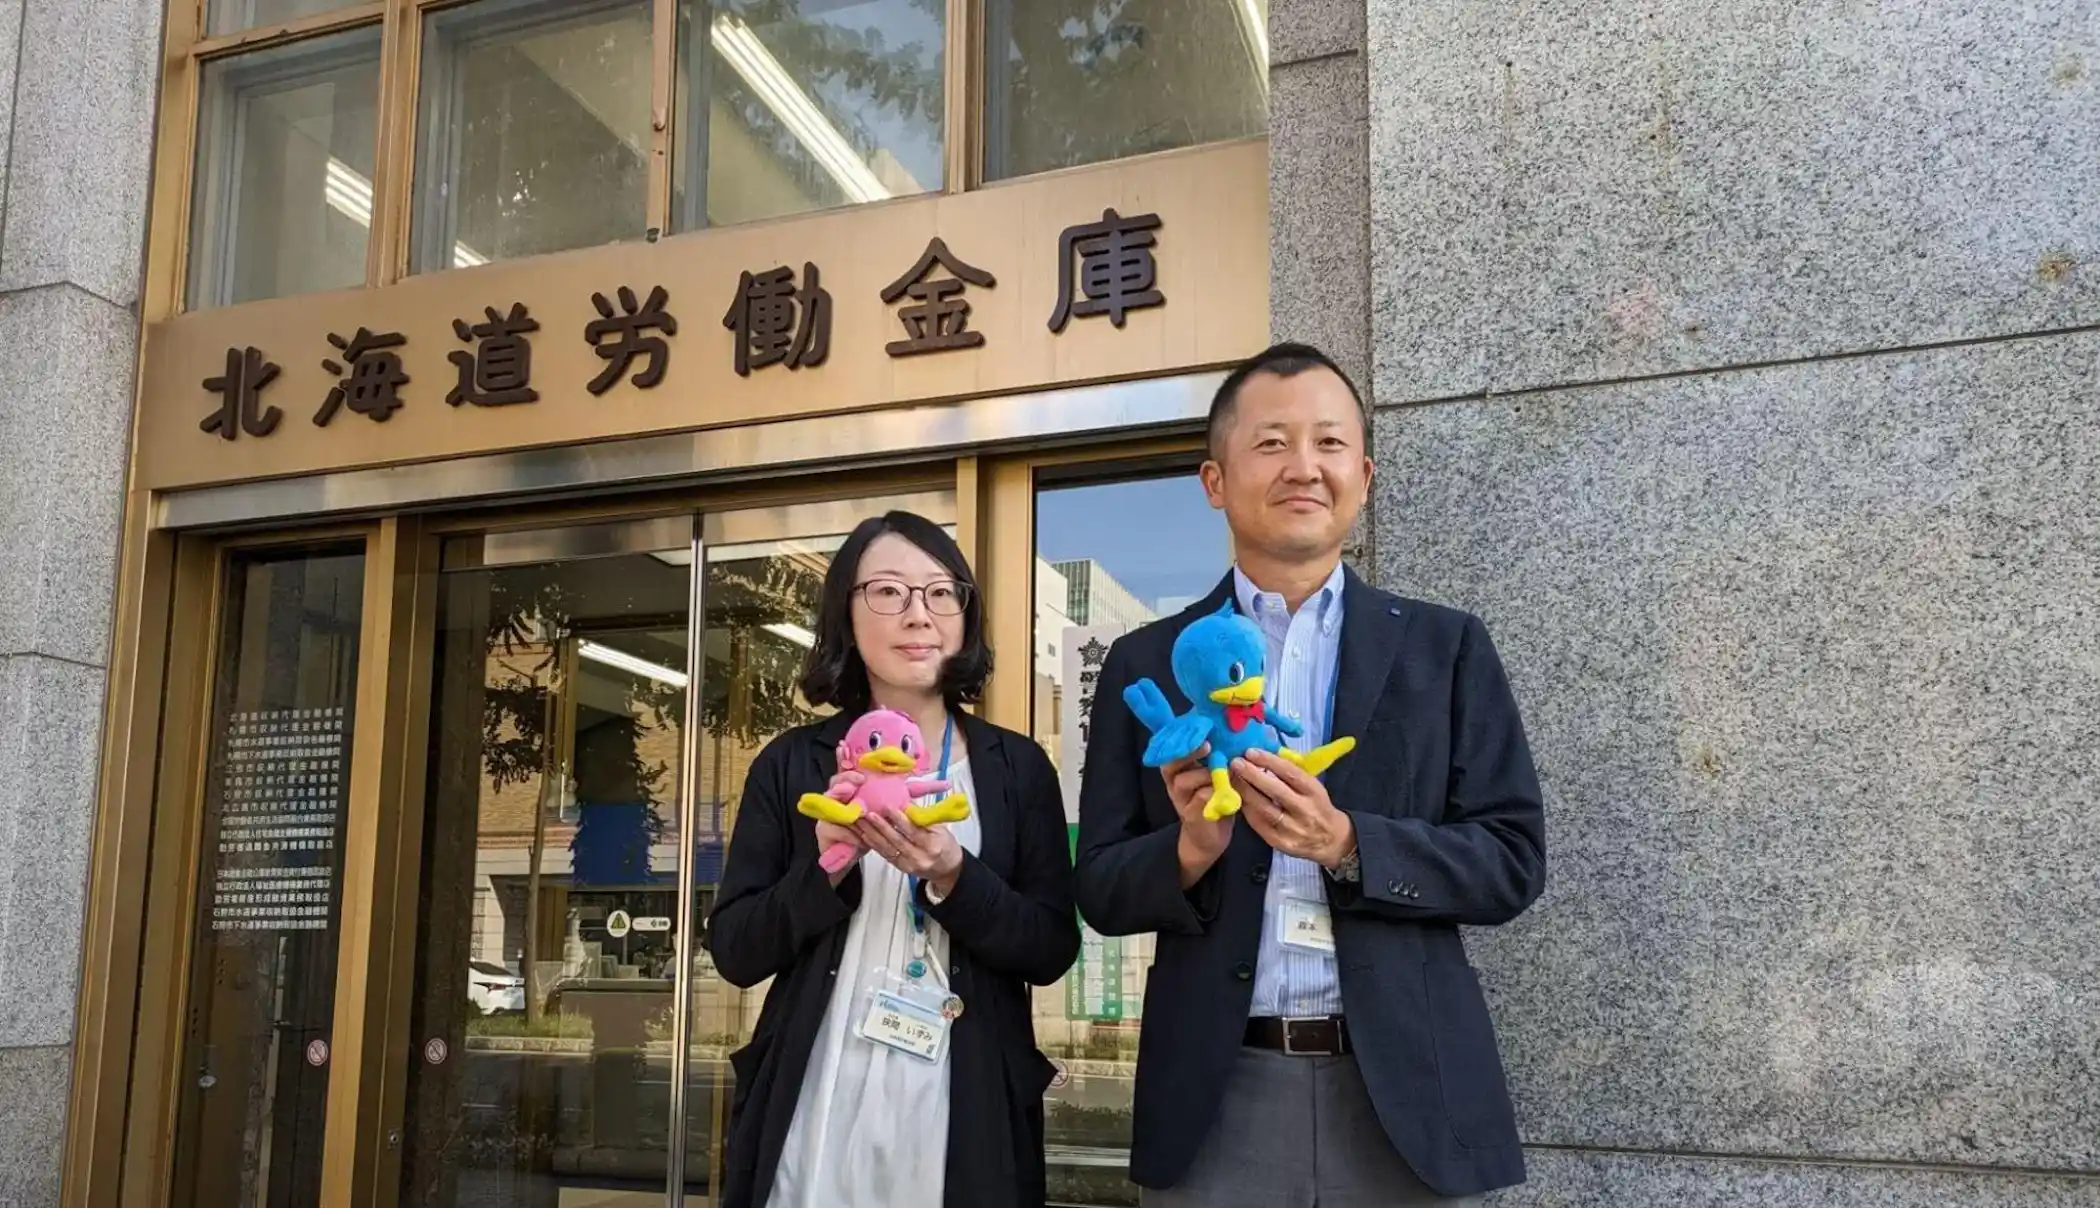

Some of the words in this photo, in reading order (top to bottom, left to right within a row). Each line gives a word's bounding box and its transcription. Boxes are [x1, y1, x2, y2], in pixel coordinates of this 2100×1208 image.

[200, 207, 1167, 441] 北海道労働金庫
